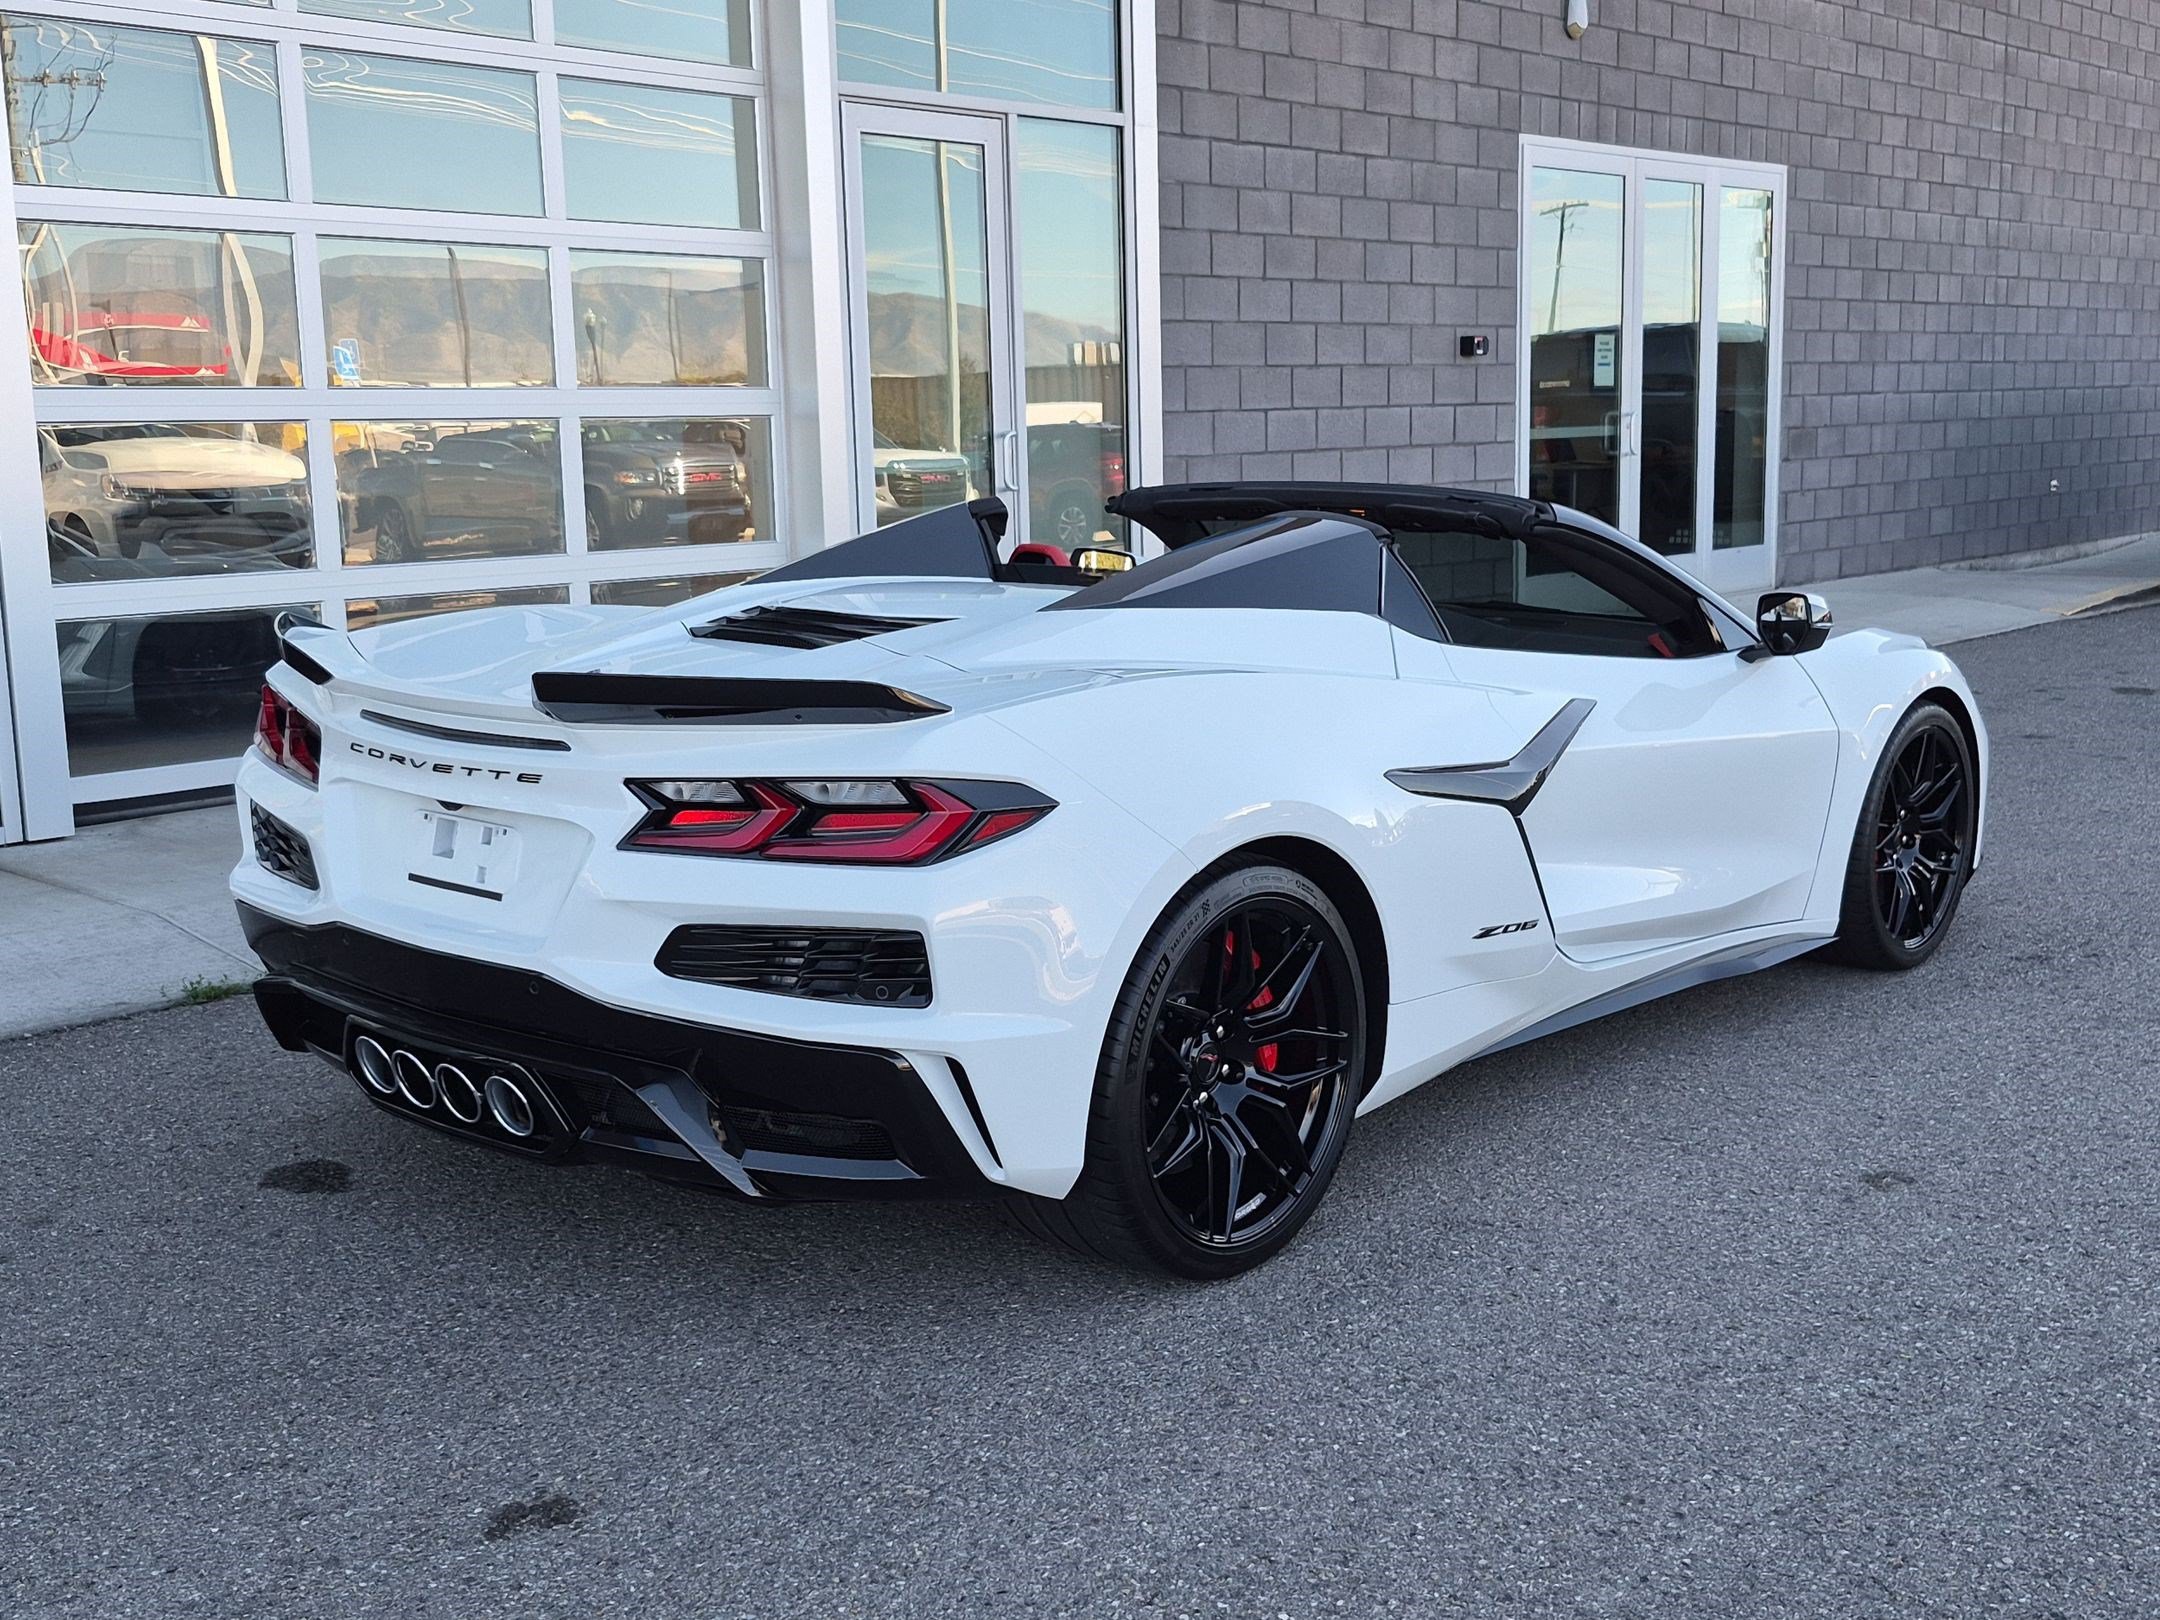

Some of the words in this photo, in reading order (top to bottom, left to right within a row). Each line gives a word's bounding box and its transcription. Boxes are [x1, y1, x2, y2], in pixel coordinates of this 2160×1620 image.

[350, 742, 544, 784] CORVETTE
[1471, 918, 1540, 939] Z06
[1130, 957, 1169, 1057] MICHELIN
